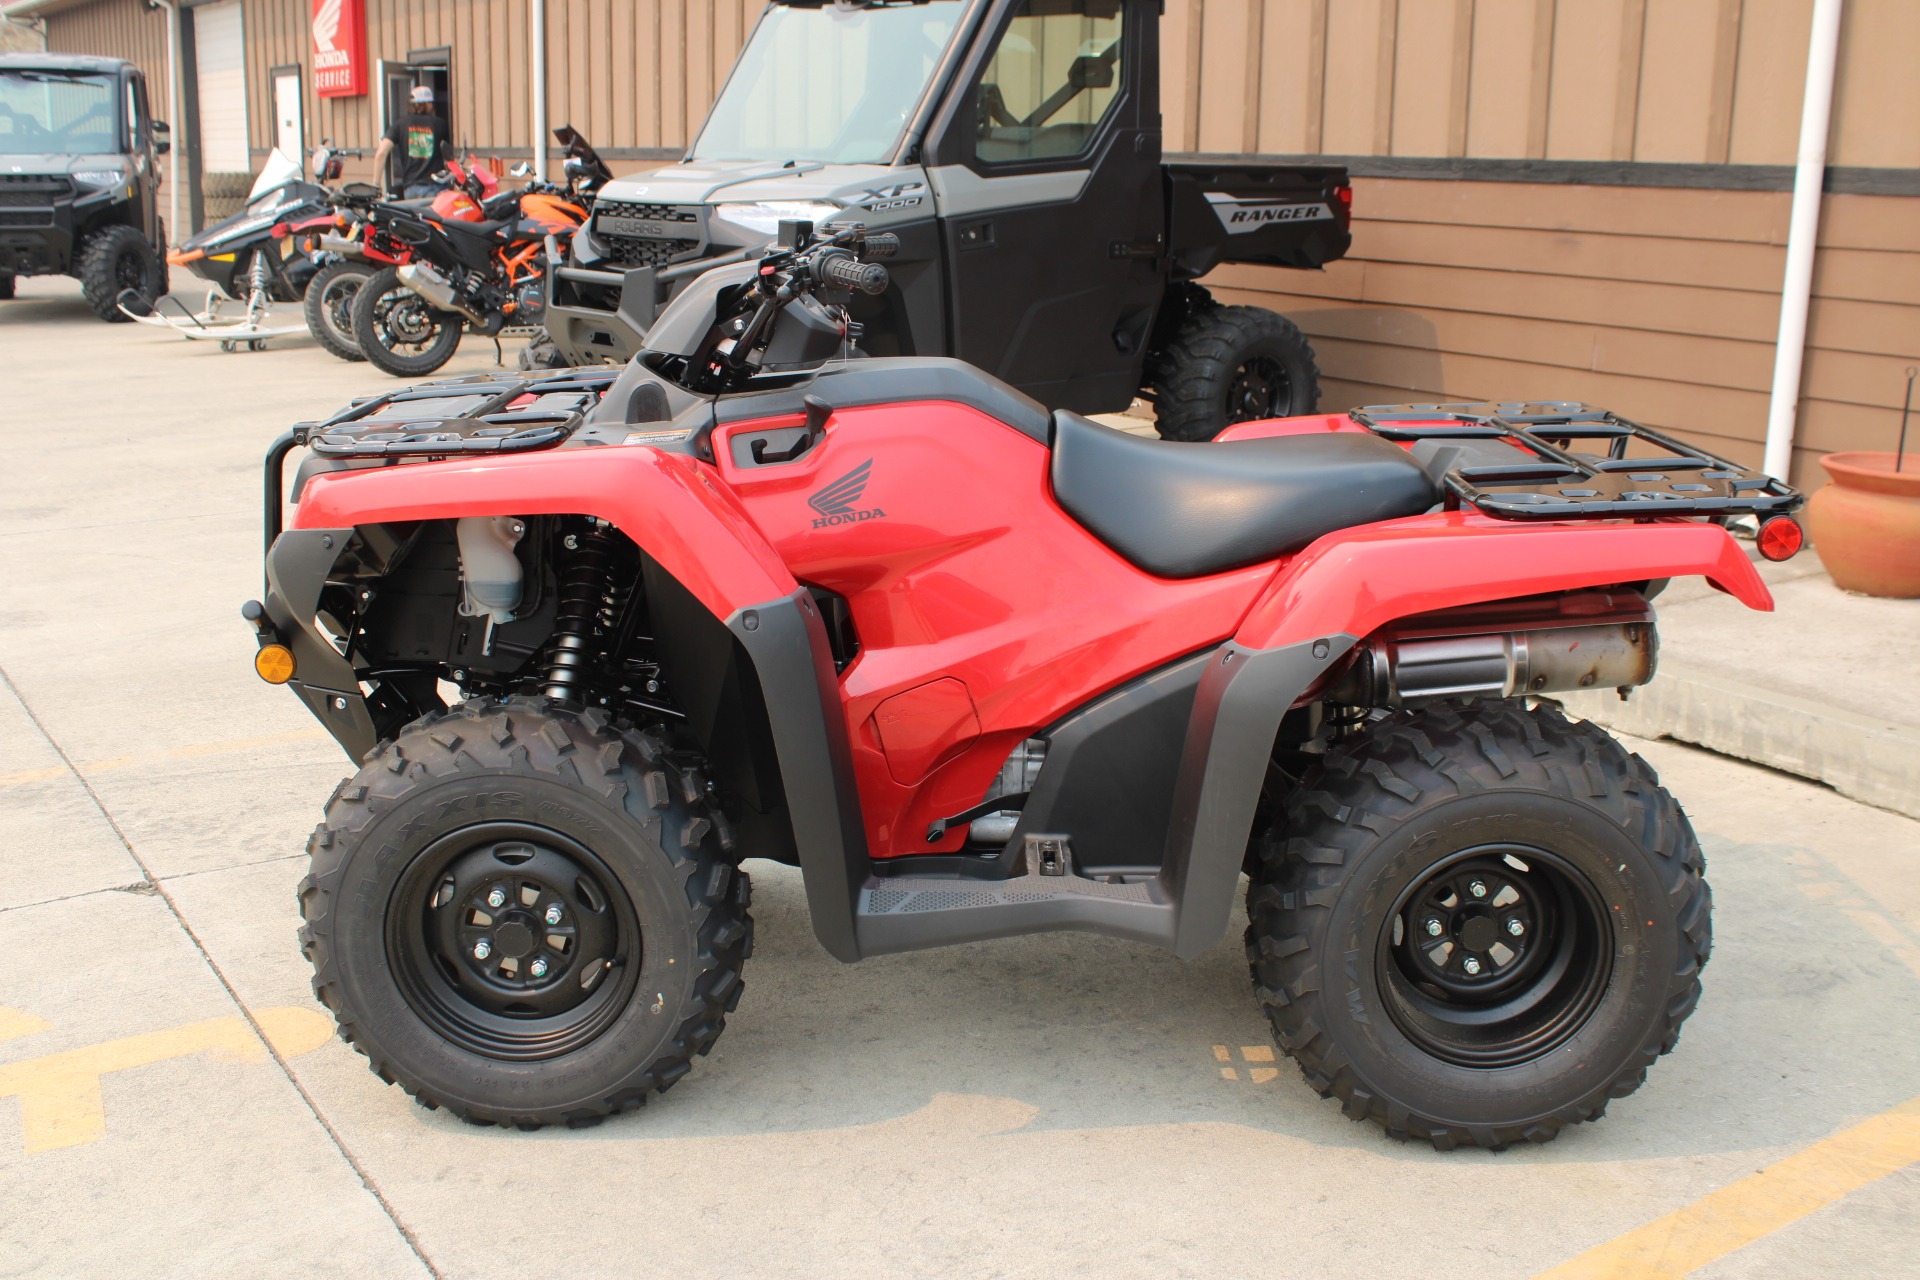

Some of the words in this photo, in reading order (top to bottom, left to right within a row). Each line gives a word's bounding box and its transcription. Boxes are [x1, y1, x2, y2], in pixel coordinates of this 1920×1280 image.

[314, 50, 350, 68] HONDA
[315, 69, 350, 89] SERVICE
[857, 182, 923, 202] XP
[871, 197, 919, 212] 1000
[1230, 206, 1321, 223] RANGER
[614, 221, 662, 235] POLARIS
[811, 508, 887, 529] HONDA
